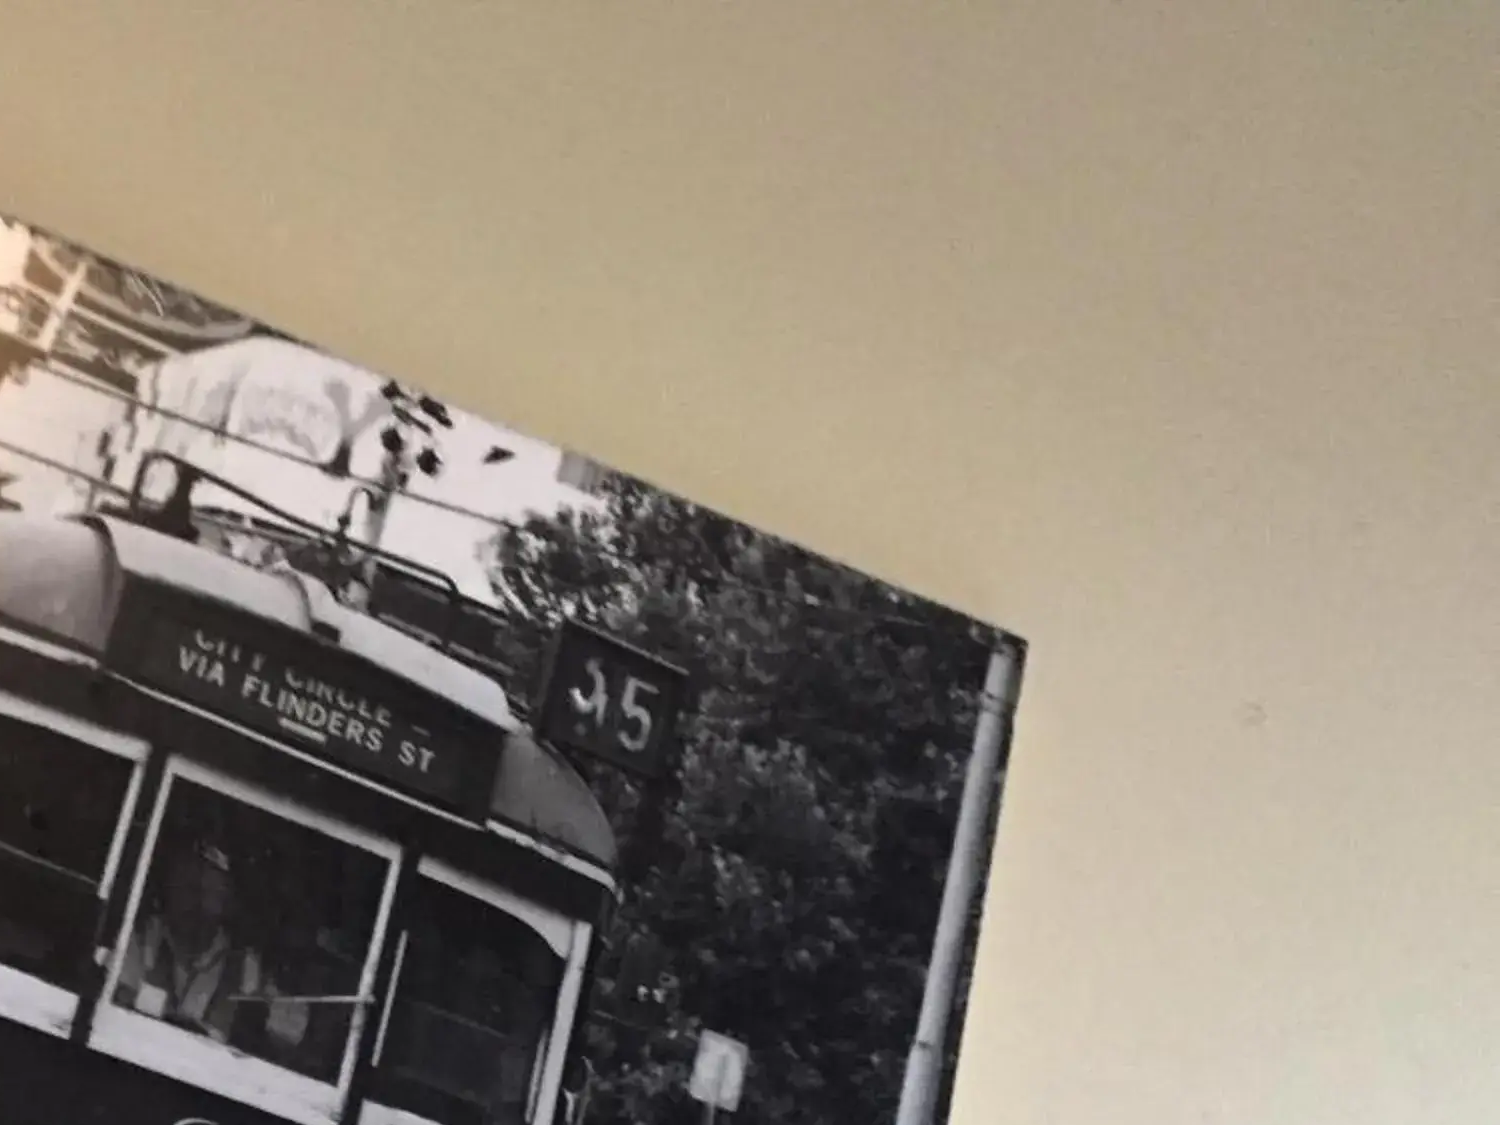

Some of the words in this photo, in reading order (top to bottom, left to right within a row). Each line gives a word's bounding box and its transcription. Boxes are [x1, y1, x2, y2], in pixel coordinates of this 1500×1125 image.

[179, 645, 225, 688] VIA
[240, 673, 384, 752] FLINDERS
[398, 740, 436, 772] ST
